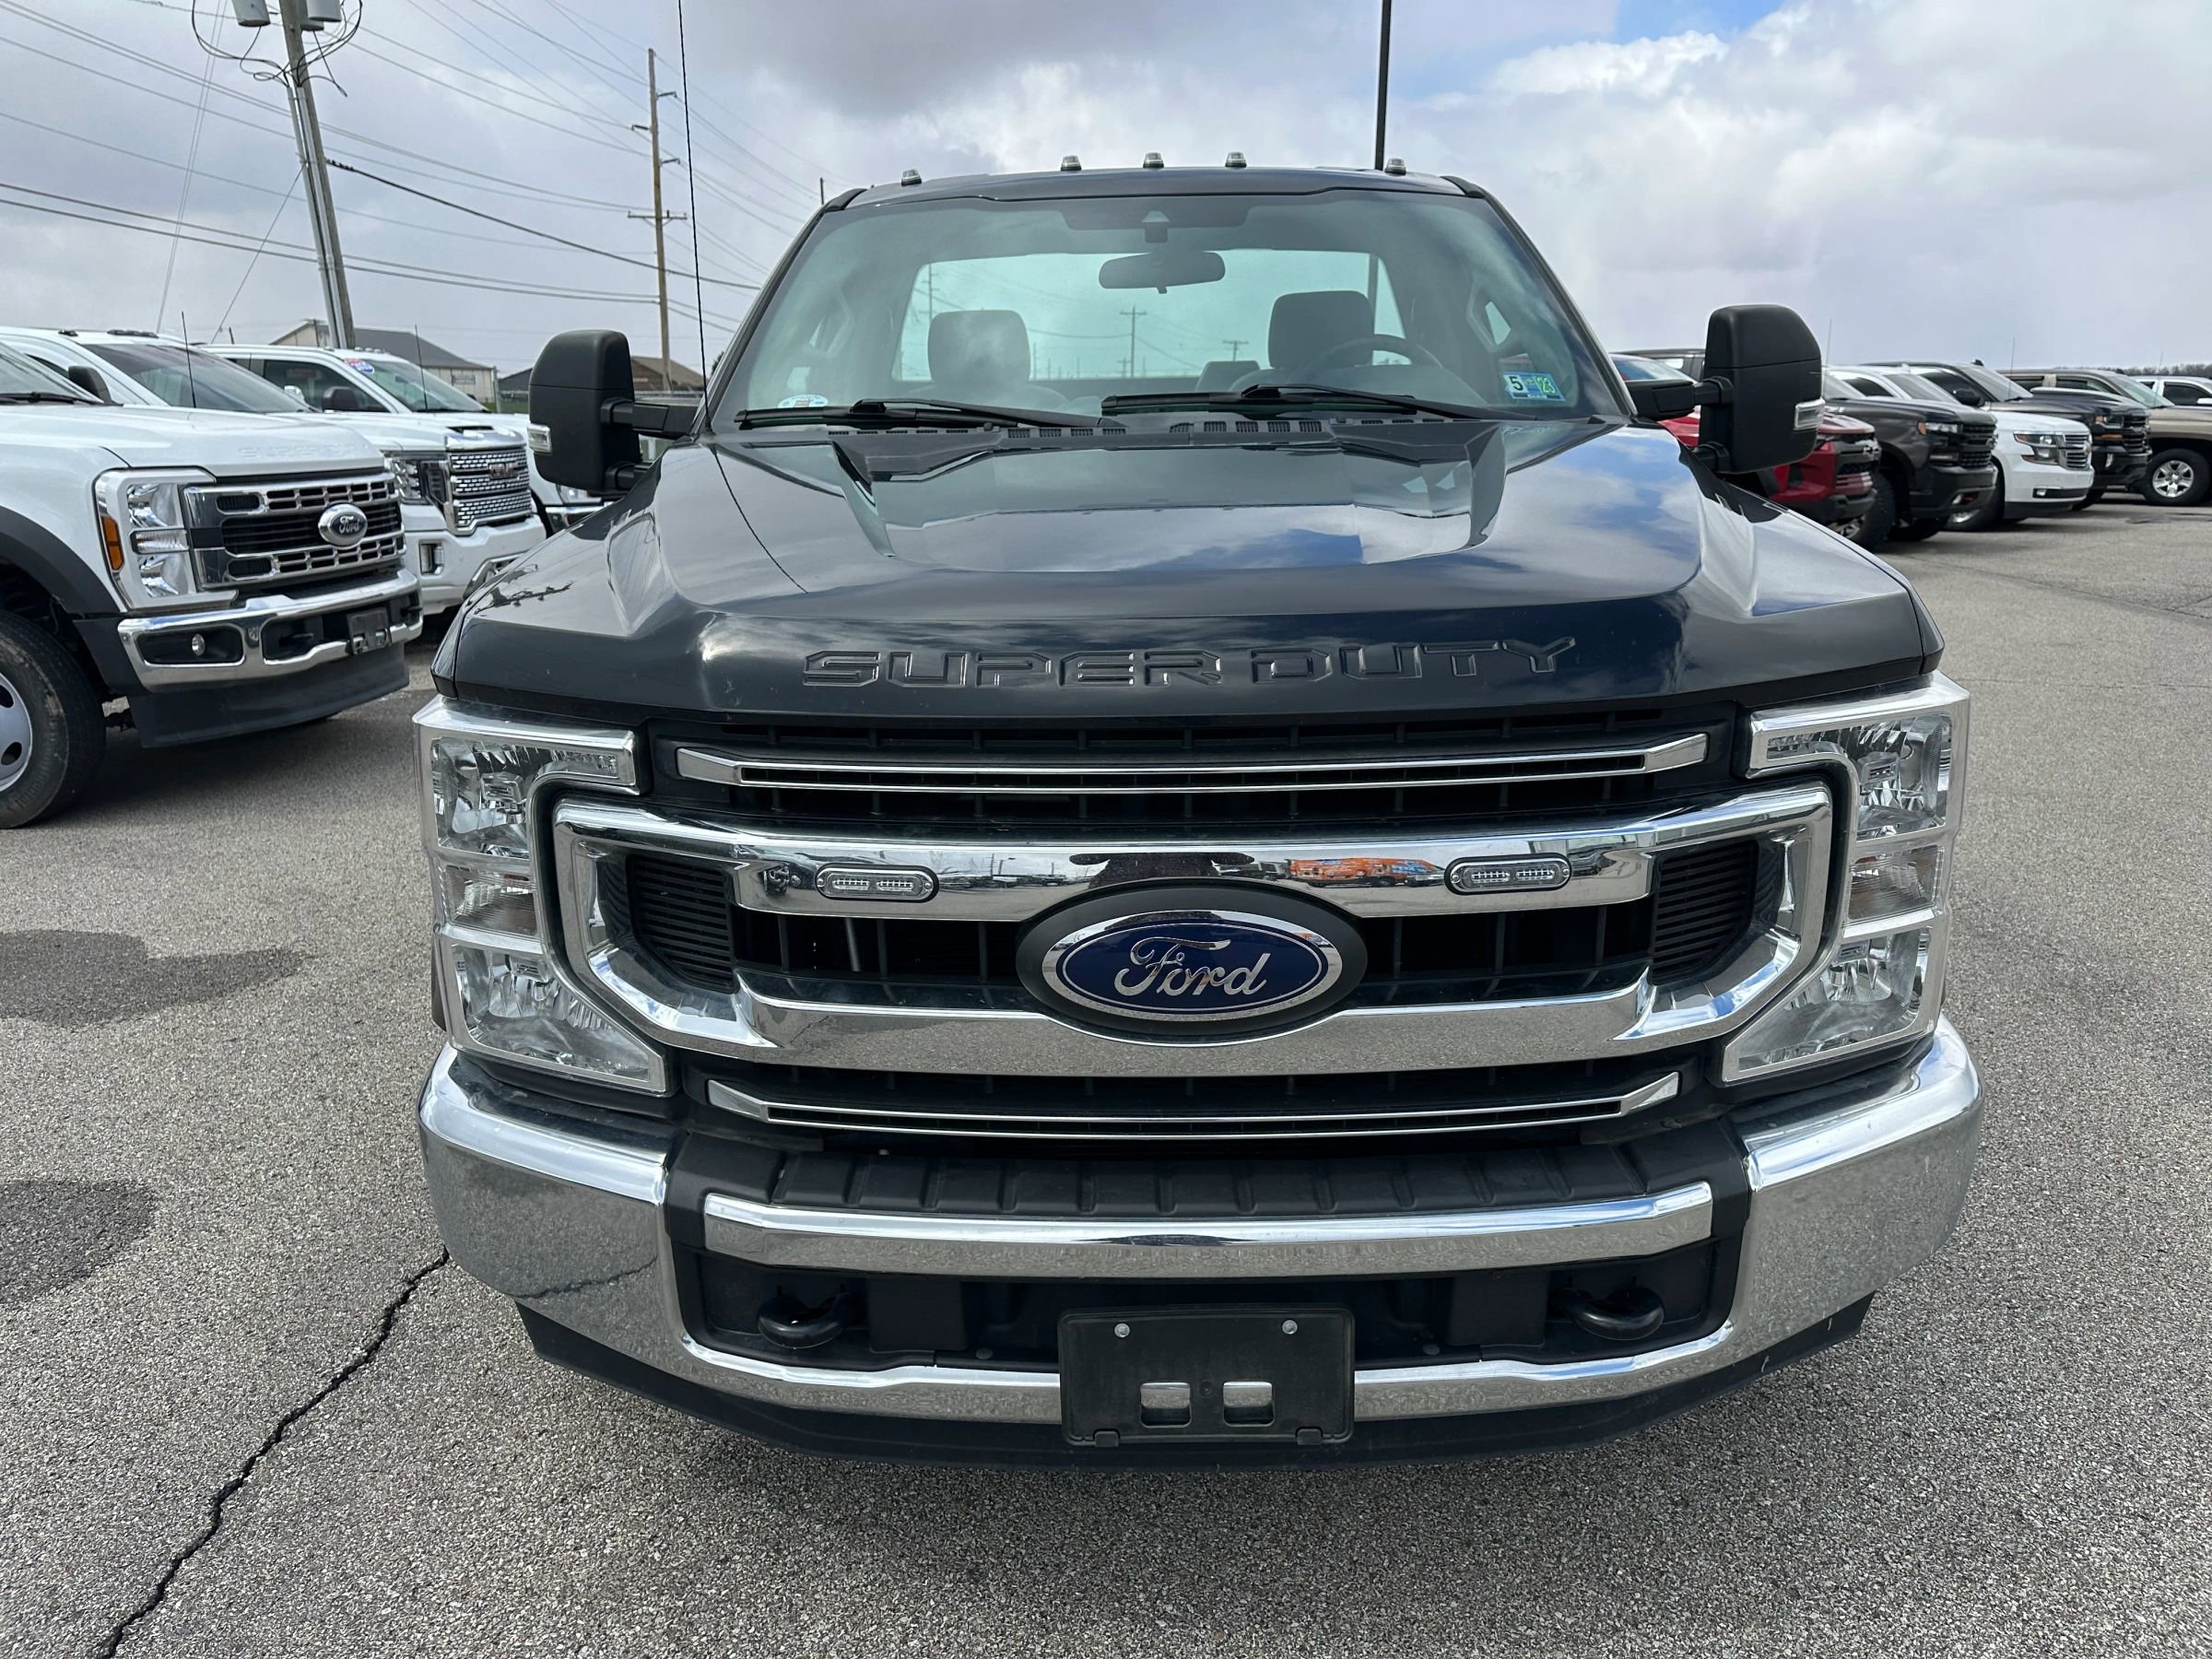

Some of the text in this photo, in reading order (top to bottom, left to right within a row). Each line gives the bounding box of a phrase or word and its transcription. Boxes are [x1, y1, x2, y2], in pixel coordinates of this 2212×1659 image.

[1509, 376, 1524, 391] 5
[338, 514, 360, 535] Ford
[803, 637, 1577, 688] SUPER DUTY
[1113, 935, 1271, 997] Ford
